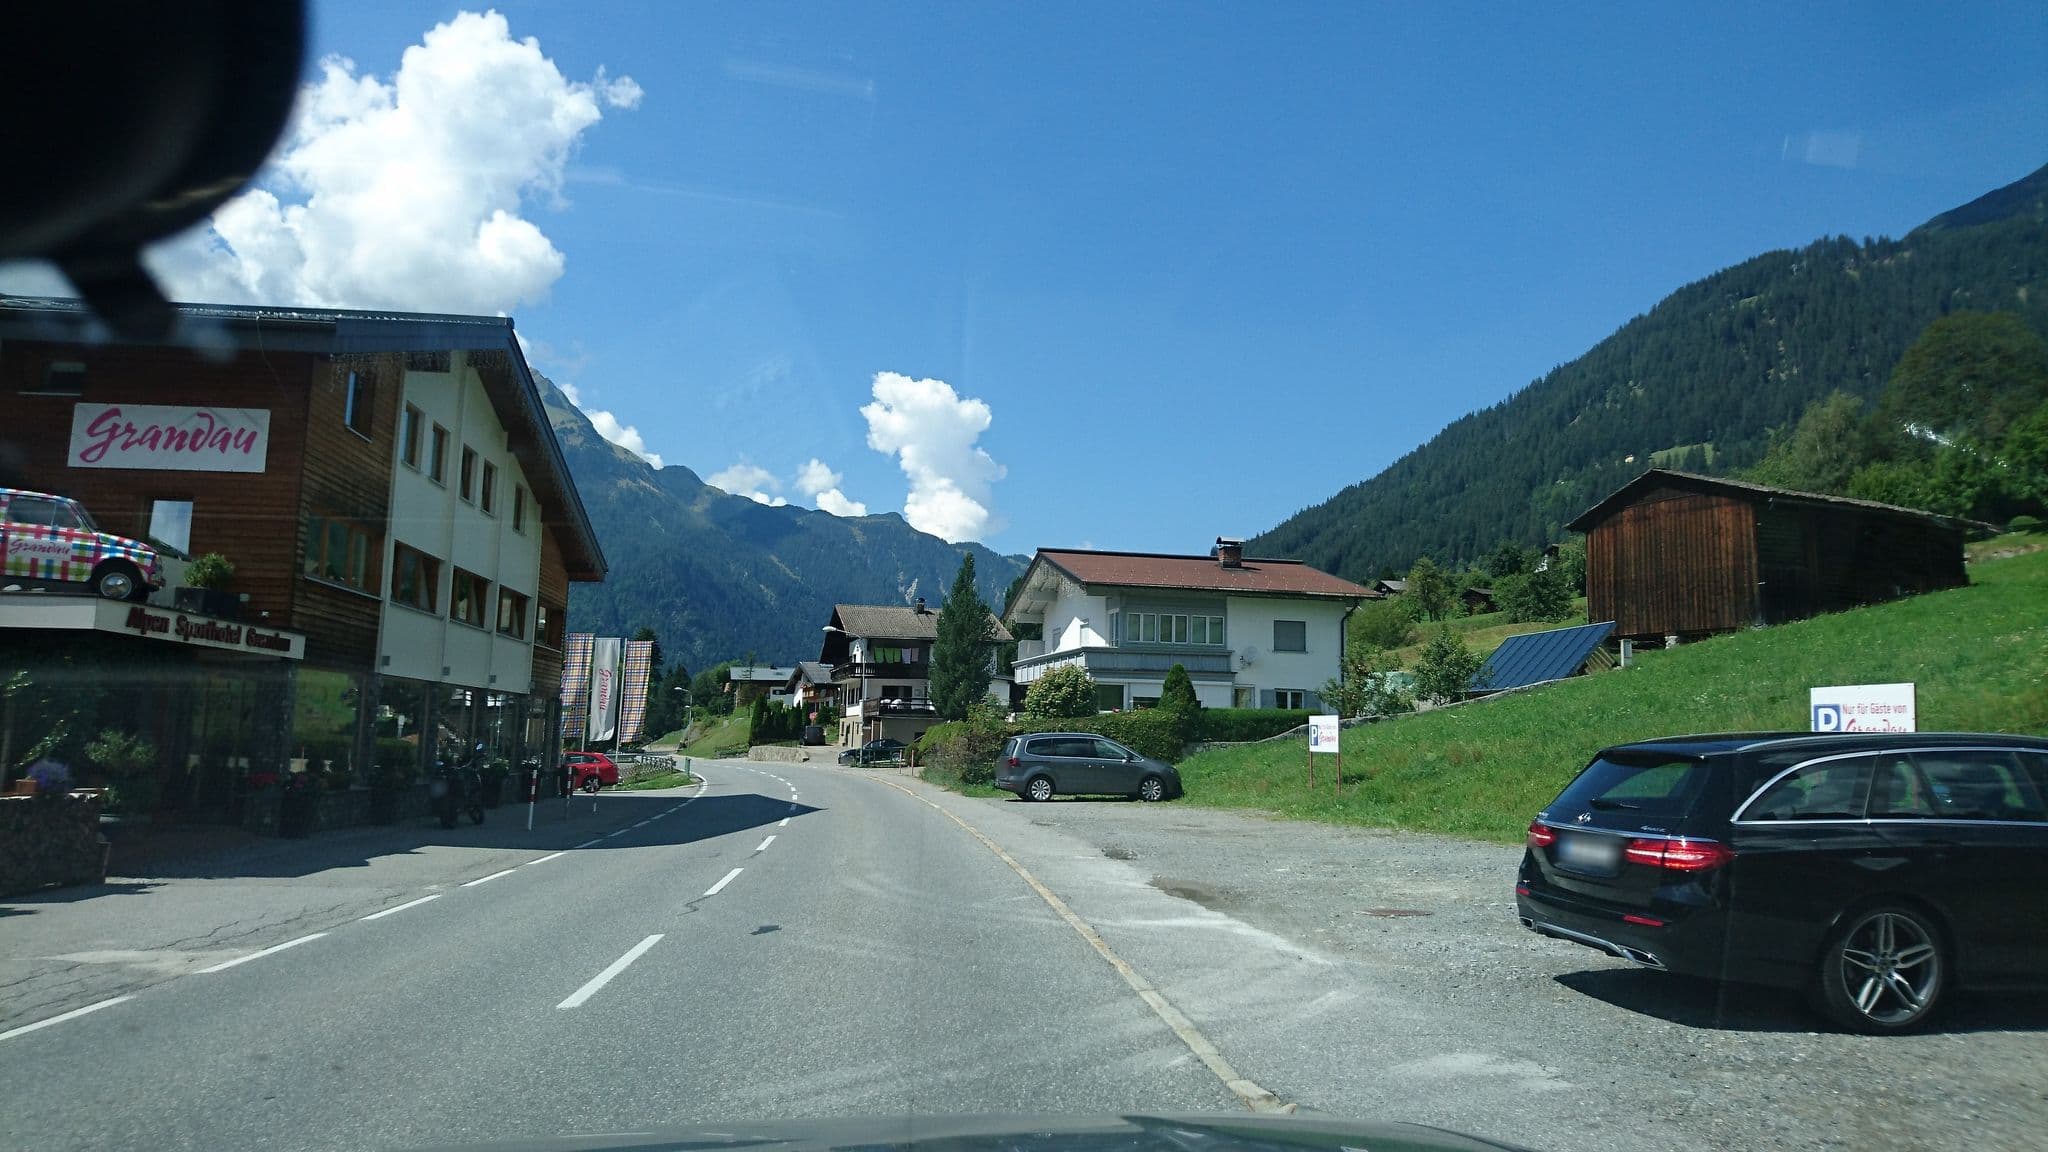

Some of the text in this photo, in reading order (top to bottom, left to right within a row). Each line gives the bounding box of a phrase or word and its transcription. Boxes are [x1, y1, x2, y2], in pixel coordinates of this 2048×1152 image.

[80, 407, 258, 463] Grandau
[126, 606, 170, 635] Alpen
[174, 615, 243, 645] Sporthotel
[1843, 702, 1907, 715] Nur für Gäste von
